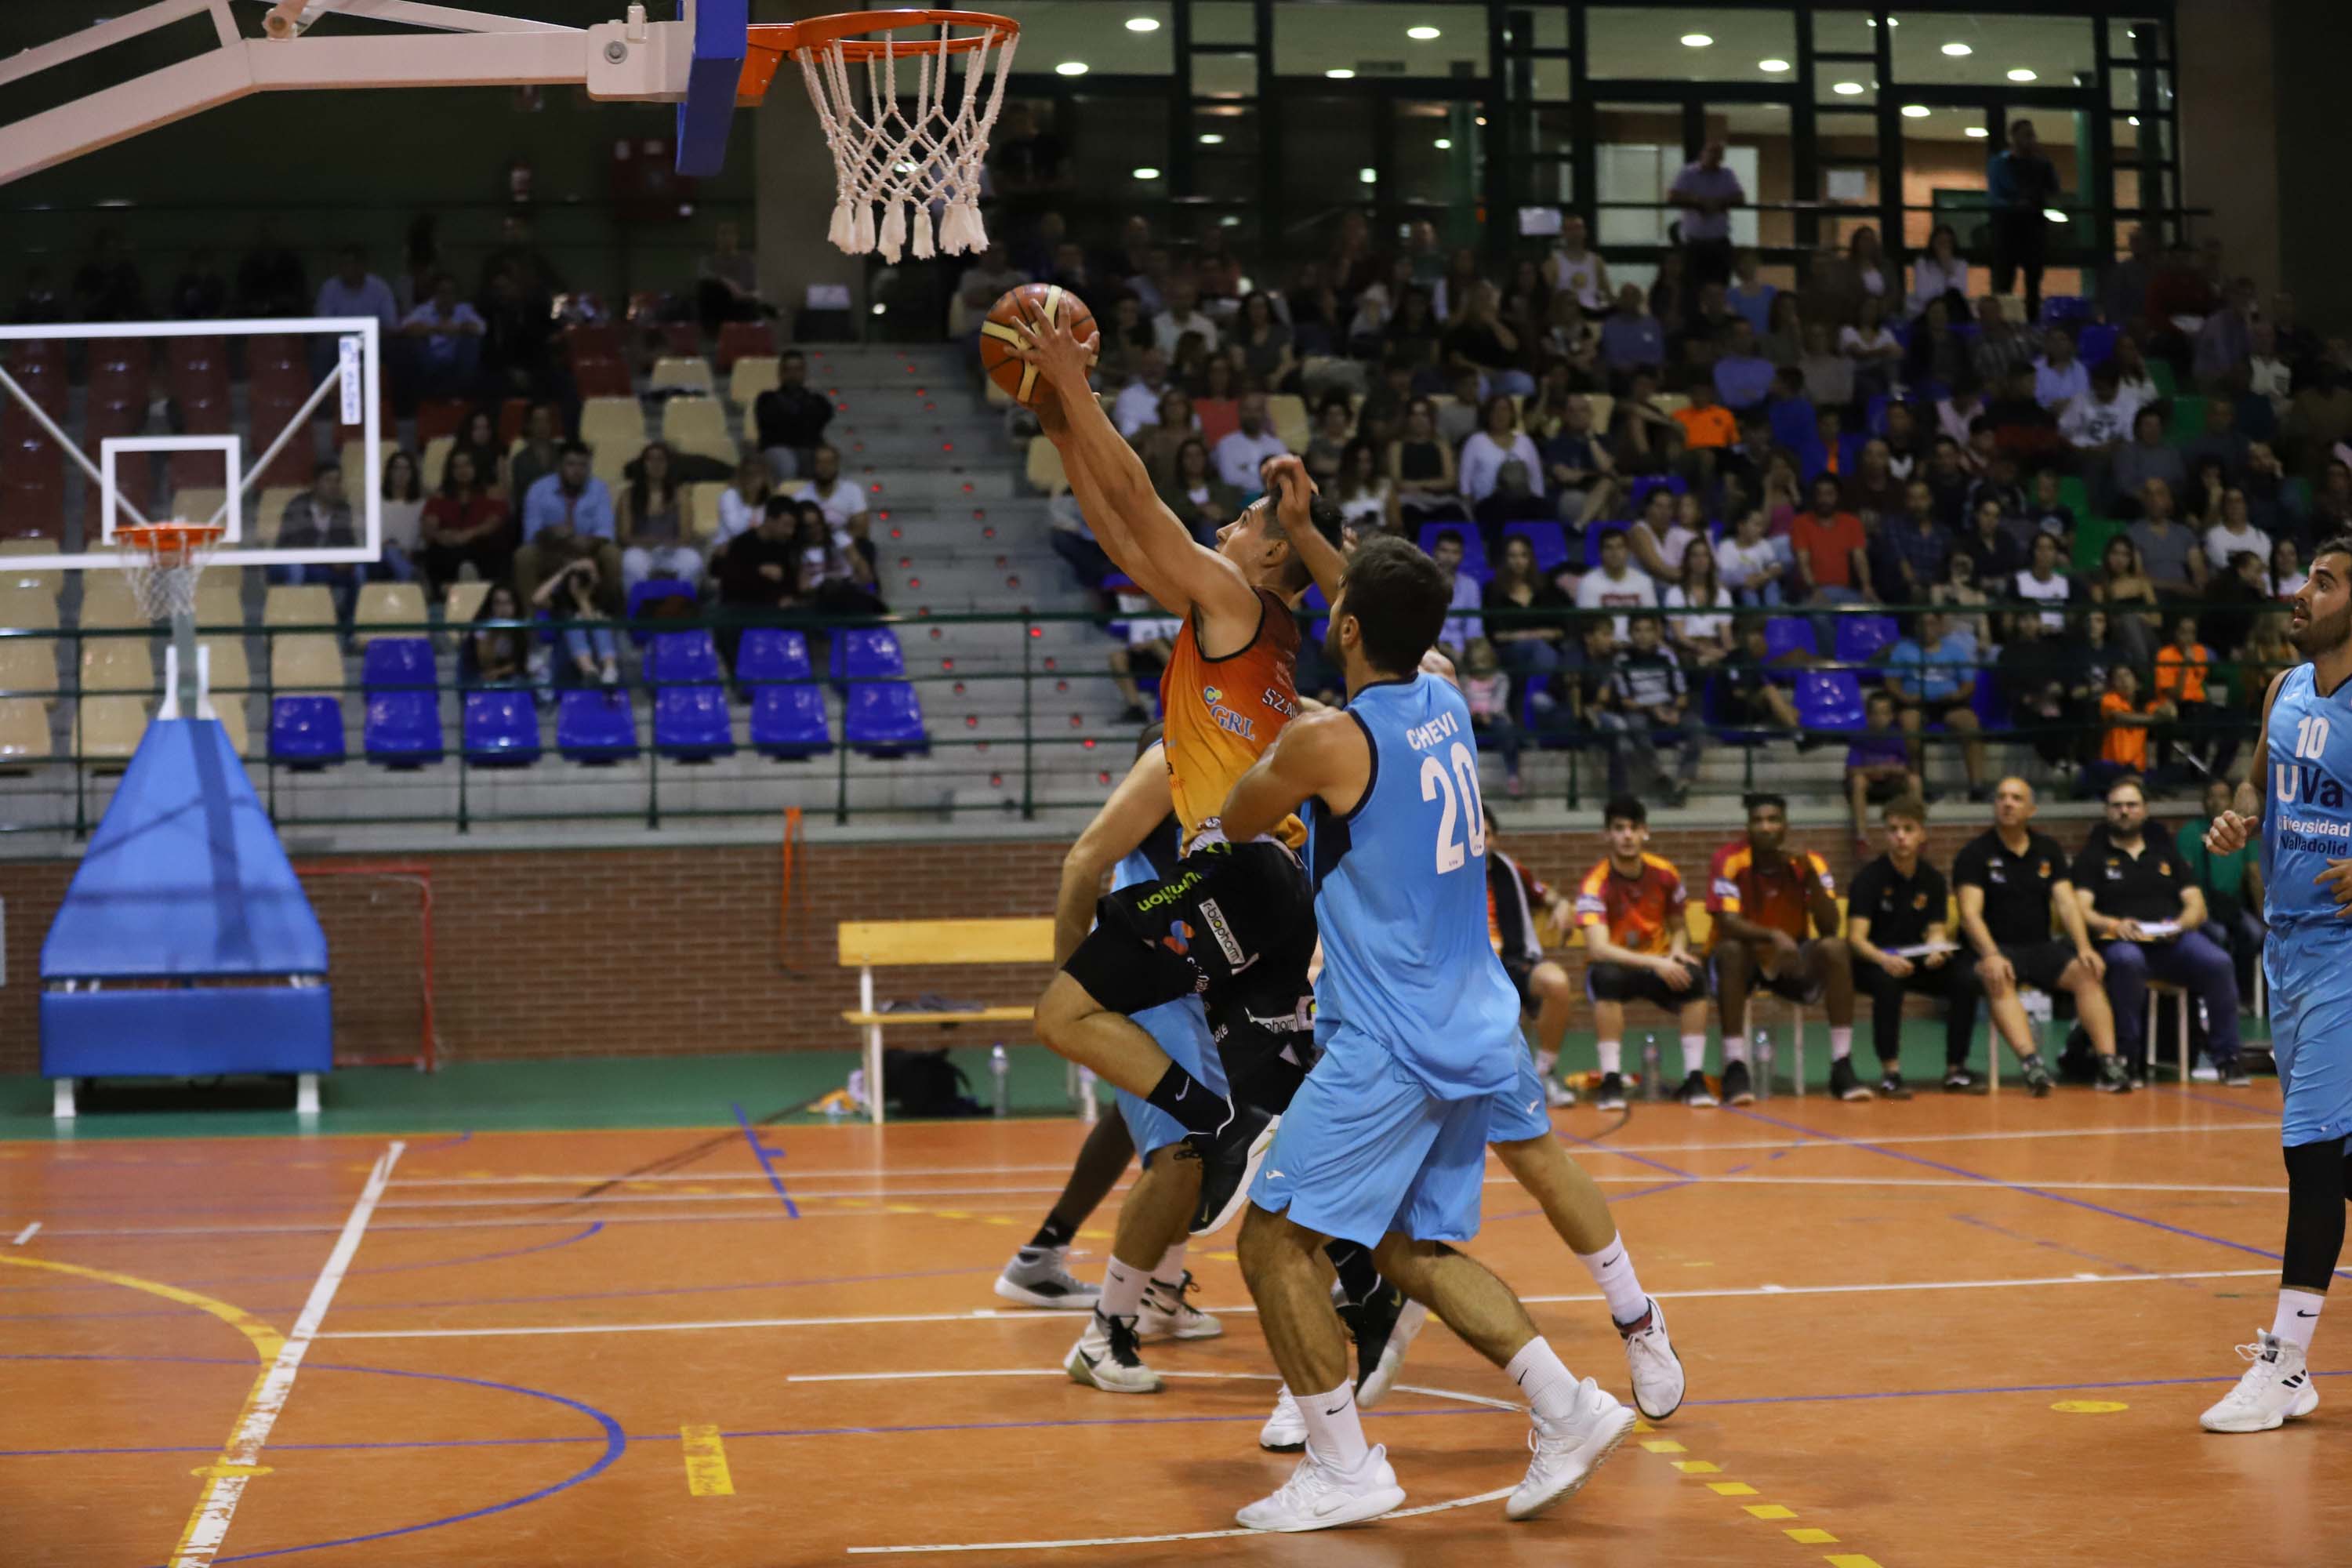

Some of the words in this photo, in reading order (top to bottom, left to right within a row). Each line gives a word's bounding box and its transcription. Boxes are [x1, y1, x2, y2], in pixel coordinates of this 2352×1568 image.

[1210, 705, 1255, 740] GRL
[1406, 710, 1459, 750] CHEVI
[2295, 715, 2330, 760] 10
[2276, 763, 2343, 808] UVa
[1420, 741, 1486, 875] 20
[2280, 835, 2347, 856] Valladolid
